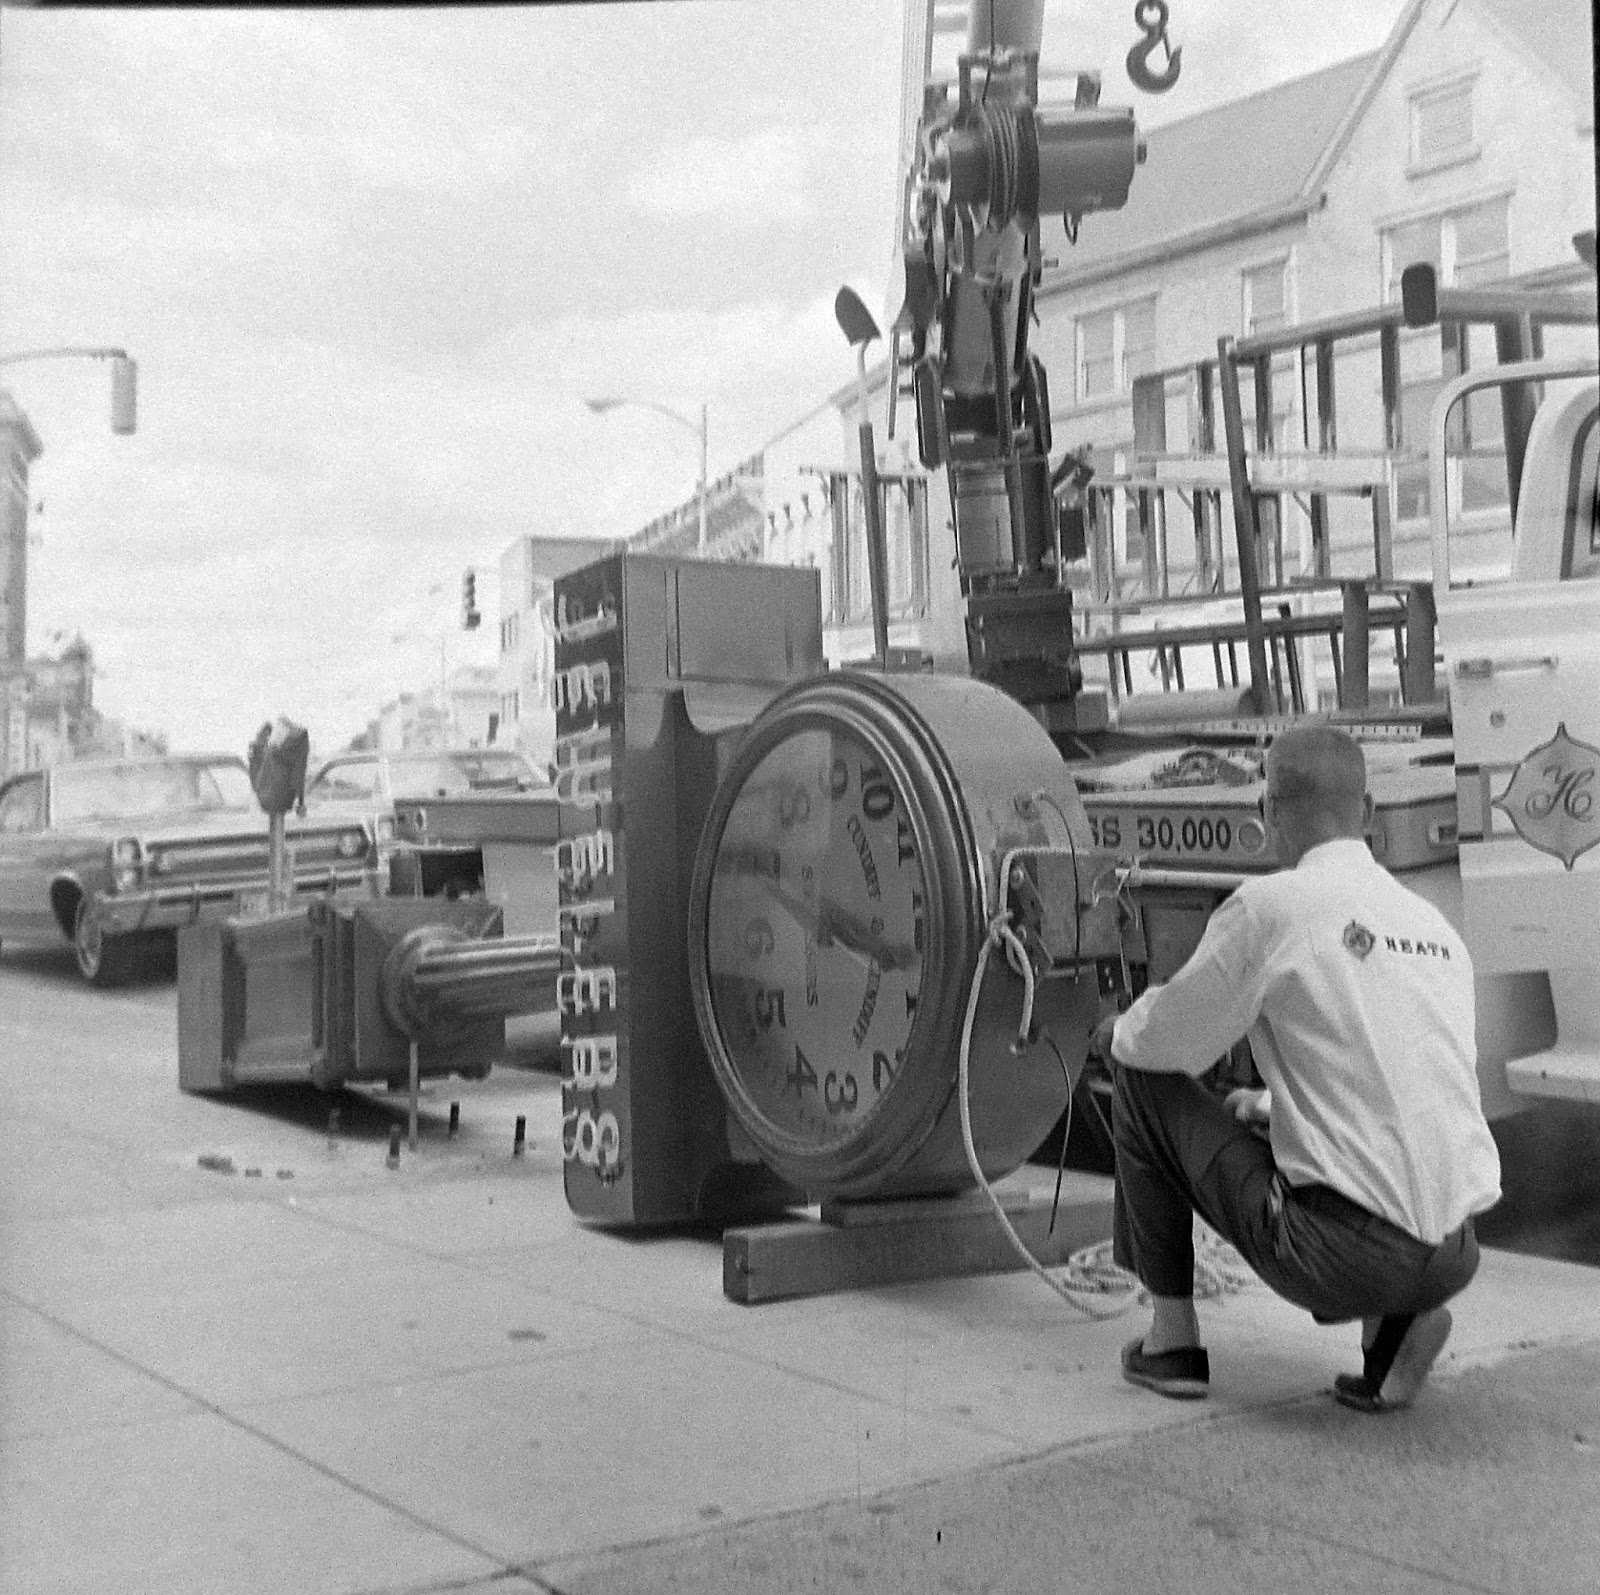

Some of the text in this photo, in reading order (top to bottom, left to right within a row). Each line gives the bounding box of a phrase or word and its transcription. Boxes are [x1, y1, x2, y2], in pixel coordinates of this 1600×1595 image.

[860, 763, 895, 821] 10
[1137, 816, 1232, 852] 30,000
[1383, 935, 1451, 961] HEATH
[755, 988, 786, 1030] 5
[786, 1043, 819, 1097] 4
[824, 1070, 858, 1115] 3
